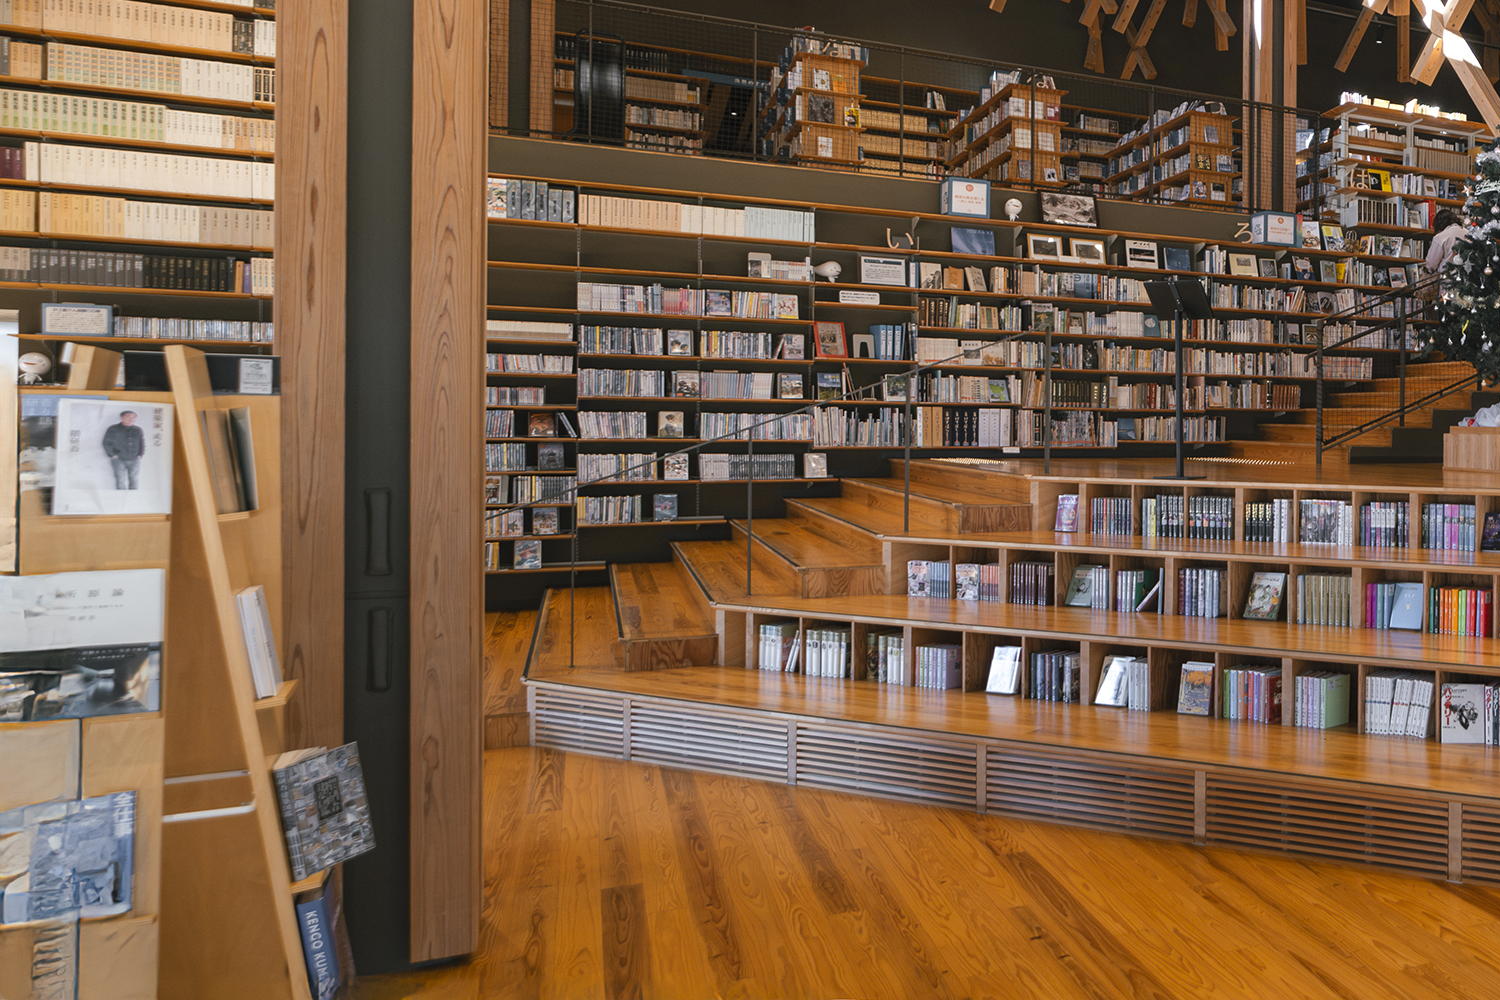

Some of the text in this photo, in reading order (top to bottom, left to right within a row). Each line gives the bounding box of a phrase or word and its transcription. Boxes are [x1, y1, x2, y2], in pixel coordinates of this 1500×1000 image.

[1233, 222, 1254, 244] ろ
[153, 407, 164, 447] 建築家、走る
[1443, 687, 1452, 726] バッテリー
[304, 909, 324, 950] KENGO
